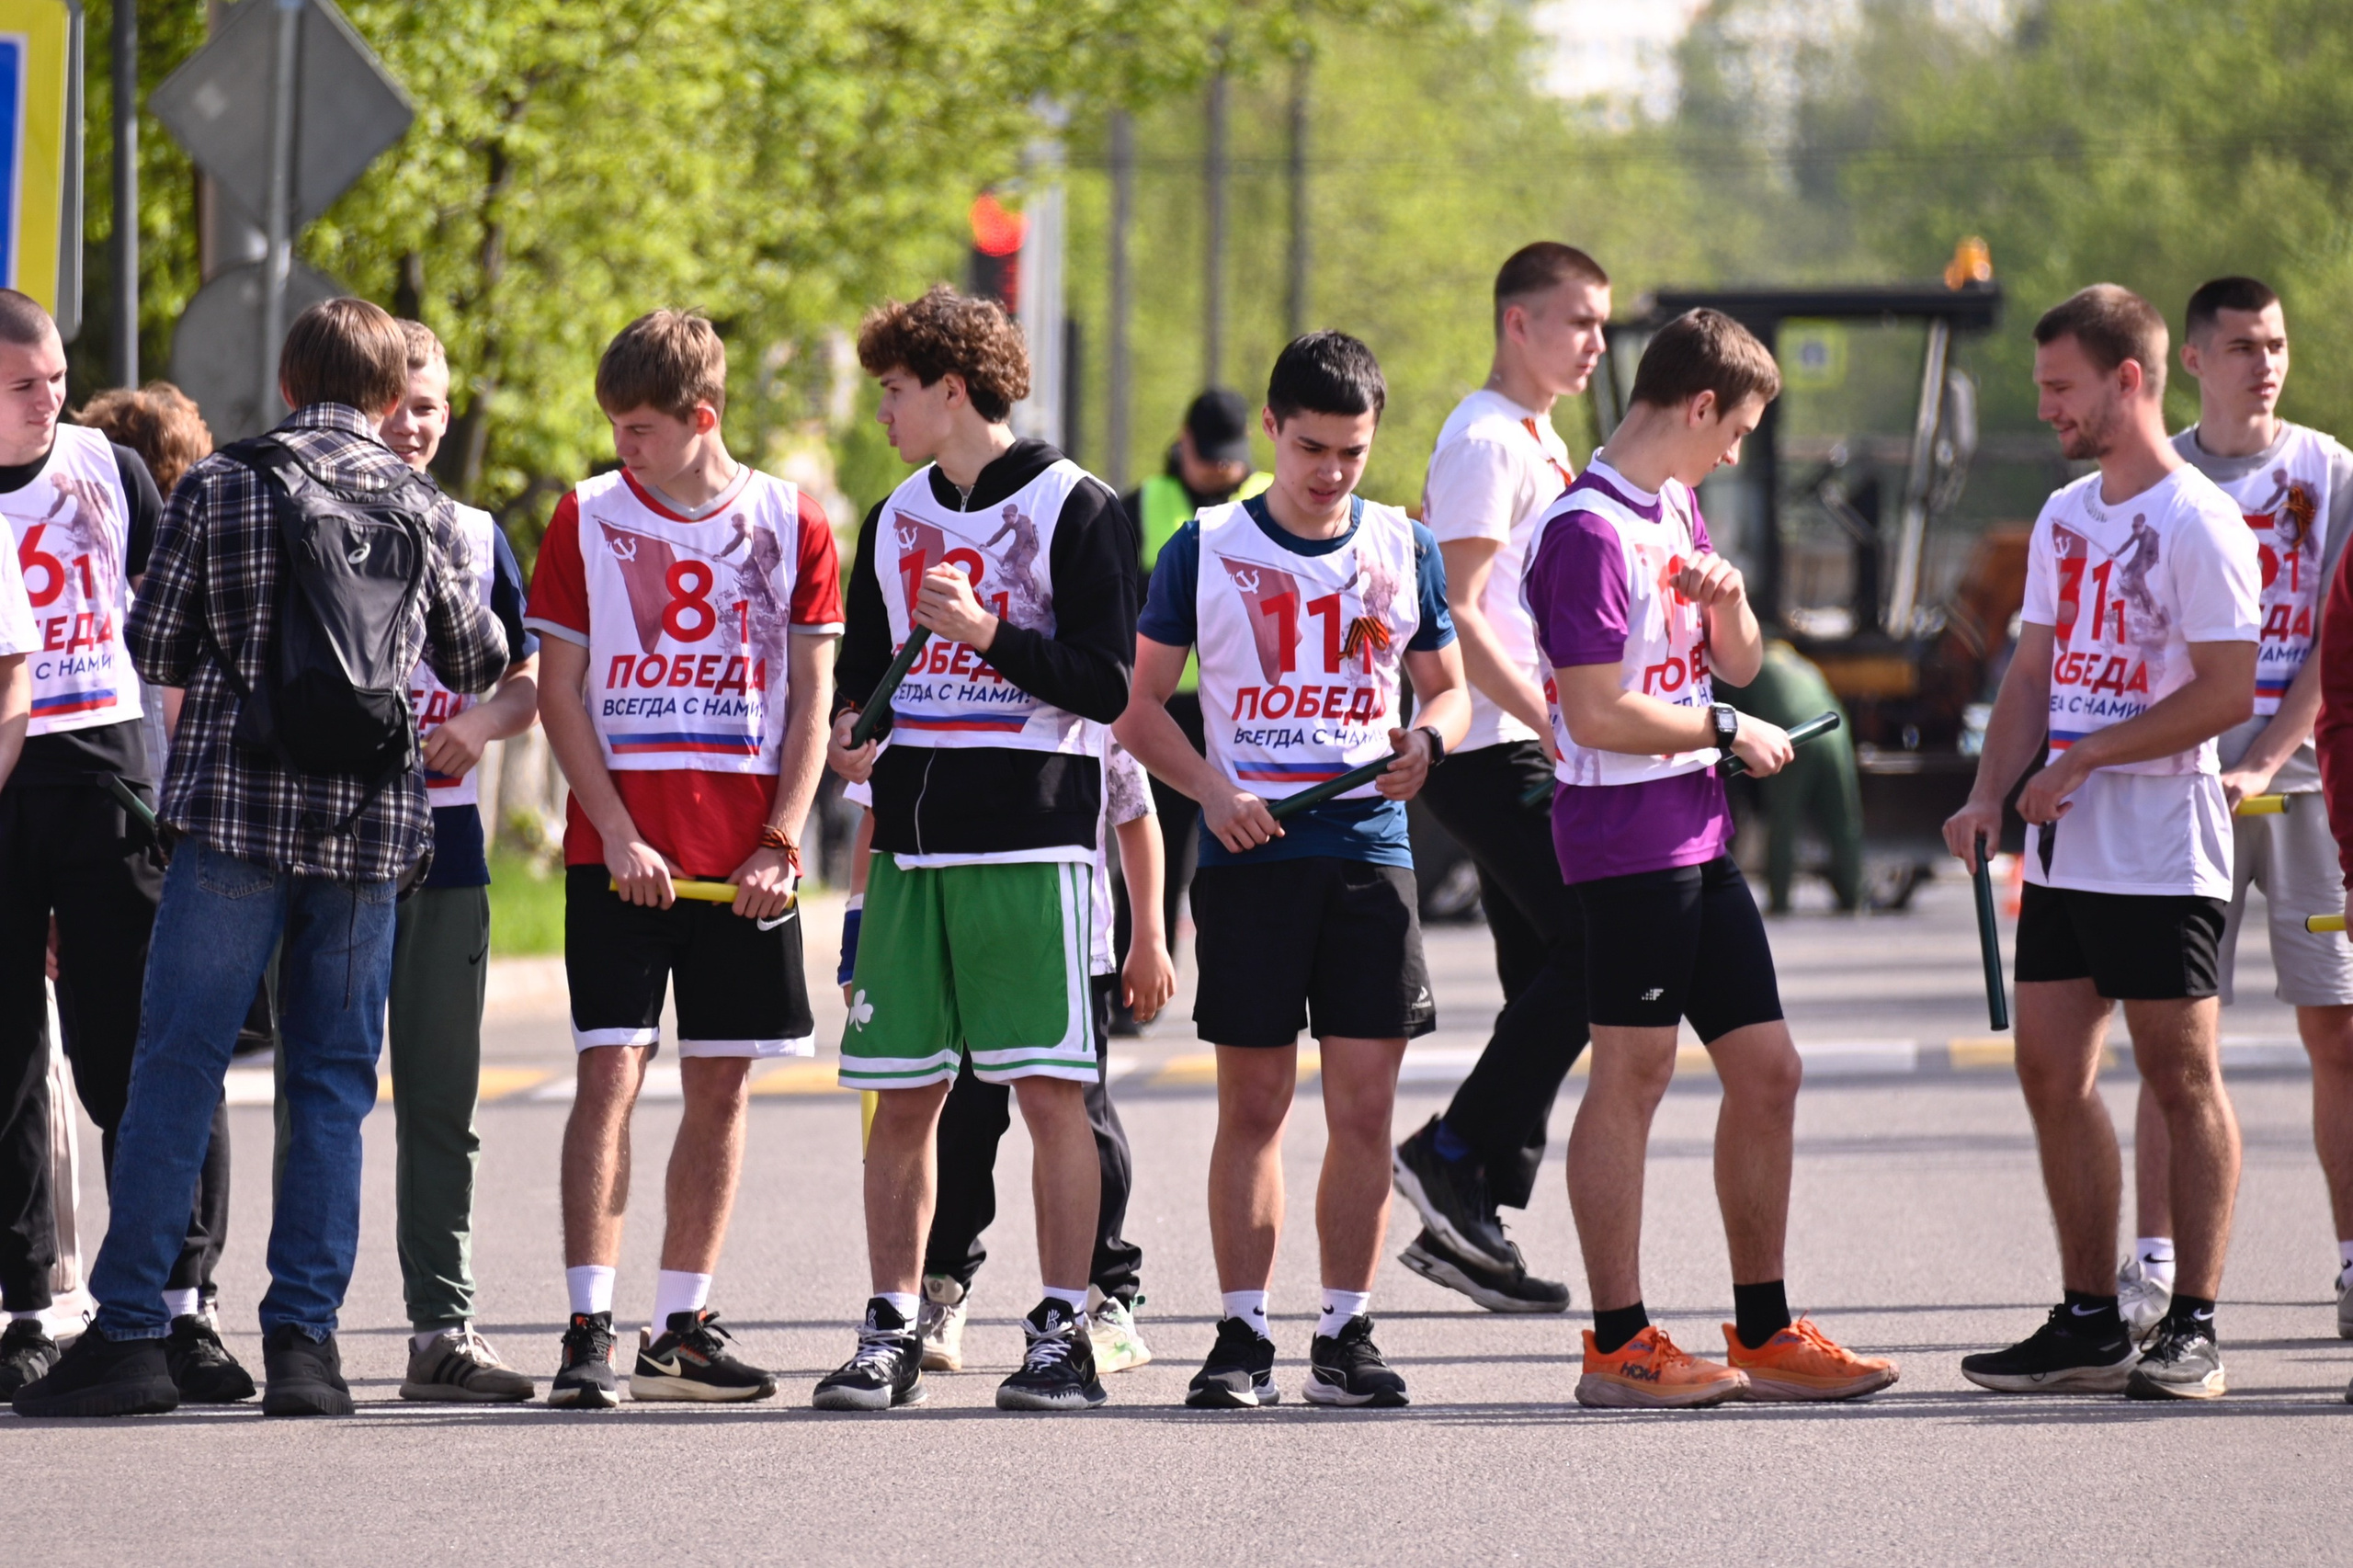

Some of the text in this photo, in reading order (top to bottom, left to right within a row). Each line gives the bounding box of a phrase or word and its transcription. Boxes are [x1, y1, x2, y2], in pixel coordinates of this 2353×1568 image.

[72, 553, 93, 600] 1
[2283, 551, 2299, 593] 1
[662, 560, 748, 644] 8 1
[992, 591, 1008, 620] 1
[2055, 558, 2125, 644] 31 1
[35, 610, 114, 655] ЕДА
[1260, 592, 1342, 674] 11
[35, 662, 51, 680] С
[606, 653, 766, 697] ПОБЕДА
[893, 642, 1005, 685] ОБЕД
[2054, 652, 2149, 698] ОБЕДА
[603, 698, 765, 719] ВСЕГДА С НАМИ!
[894, 684, 1031, 703] ЕГДА С НАМИ!
[2068, 697, 2082, 713] С
[1312, 729, 1327, 744] С
[1620, 1361, 1662, 1383] HOKA
